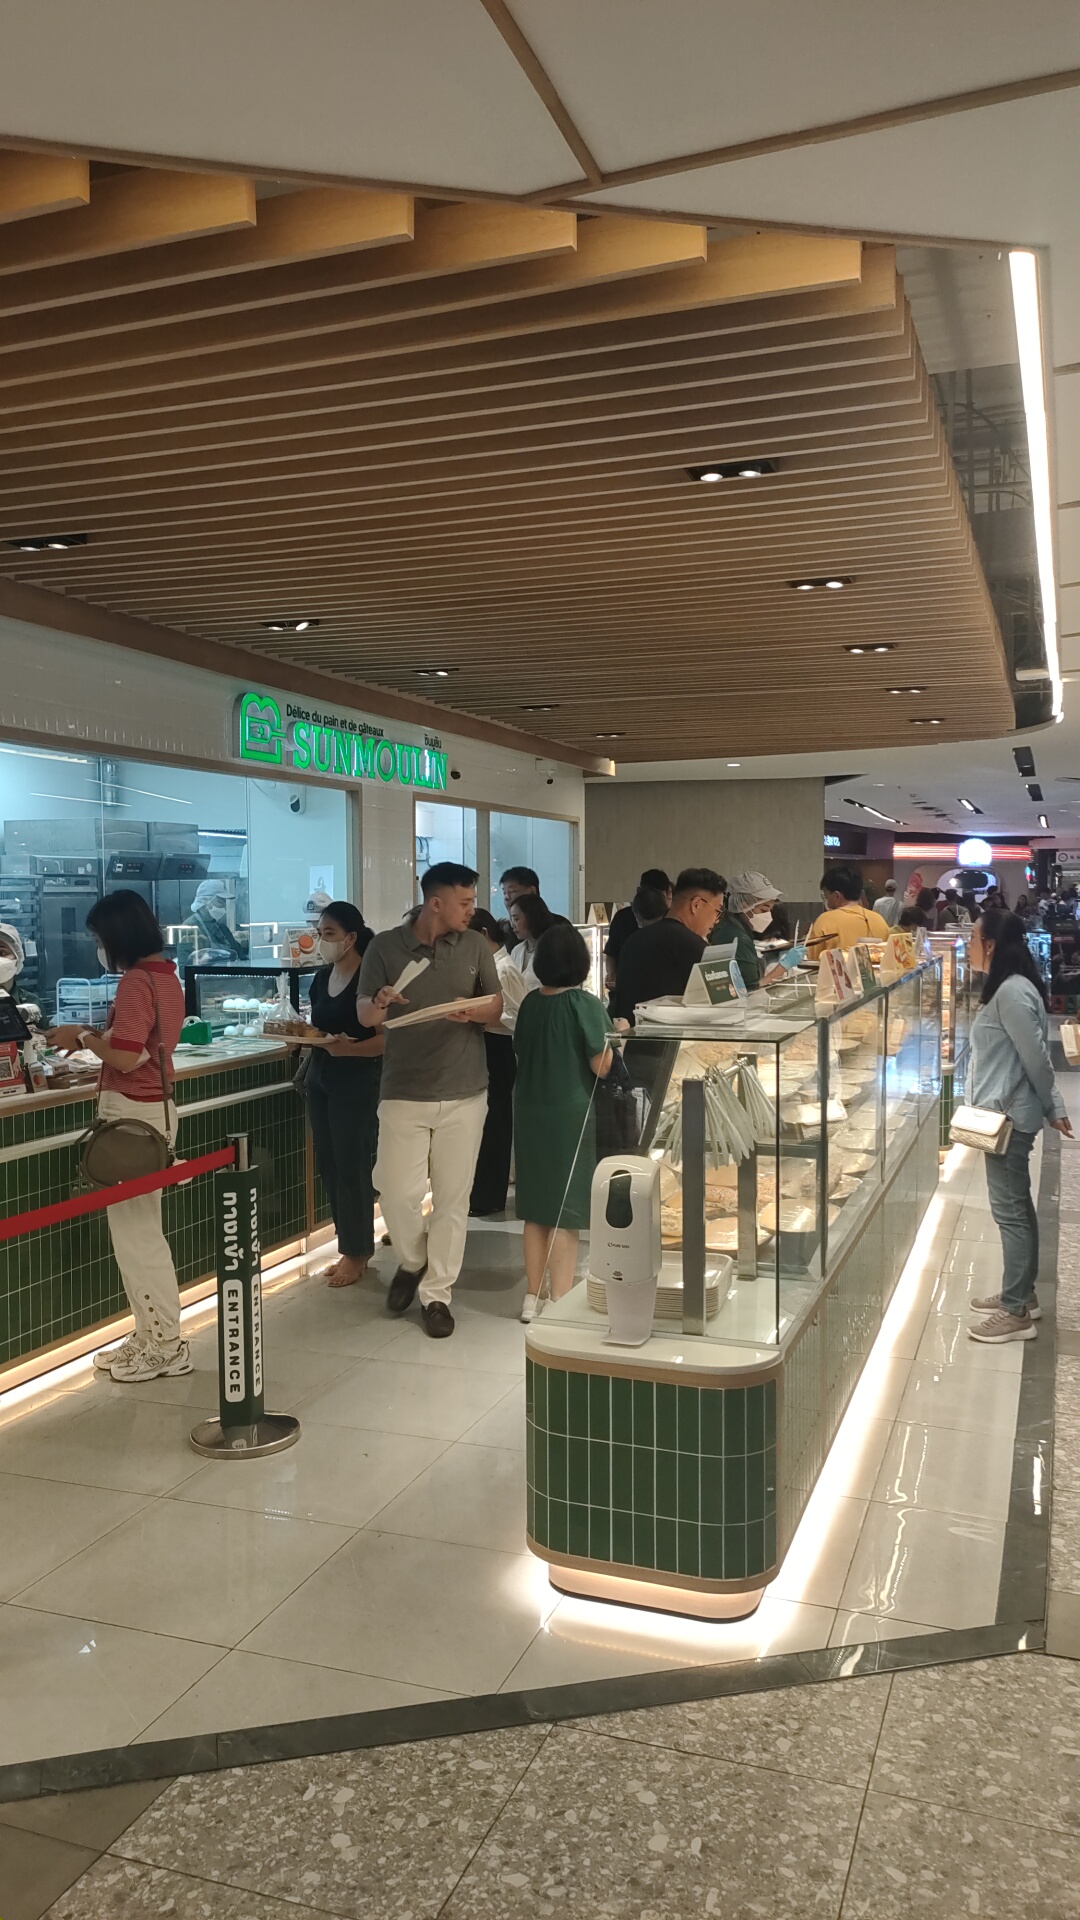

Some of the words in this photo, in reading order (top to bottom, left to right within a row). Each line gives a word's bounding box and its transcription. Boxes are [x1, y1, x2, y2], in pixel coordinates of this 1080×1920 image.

[286, 703, 310, 720] Délice
[311, 710, 322, 723] du
[323, 714, 339, 727] pain
[340, 719, 347, 730] et
[348, 719, 357, 732] de
[358, 722, 384, 737] gâteaux
[293, 720, 448, 791] SUNMOULIN
[223, 1192, 244, 1271] ทางเข้า
[227, 1289, 241, 1394] ENTRANCE
[253, 1283, 261, 1388] ENTRANCE
